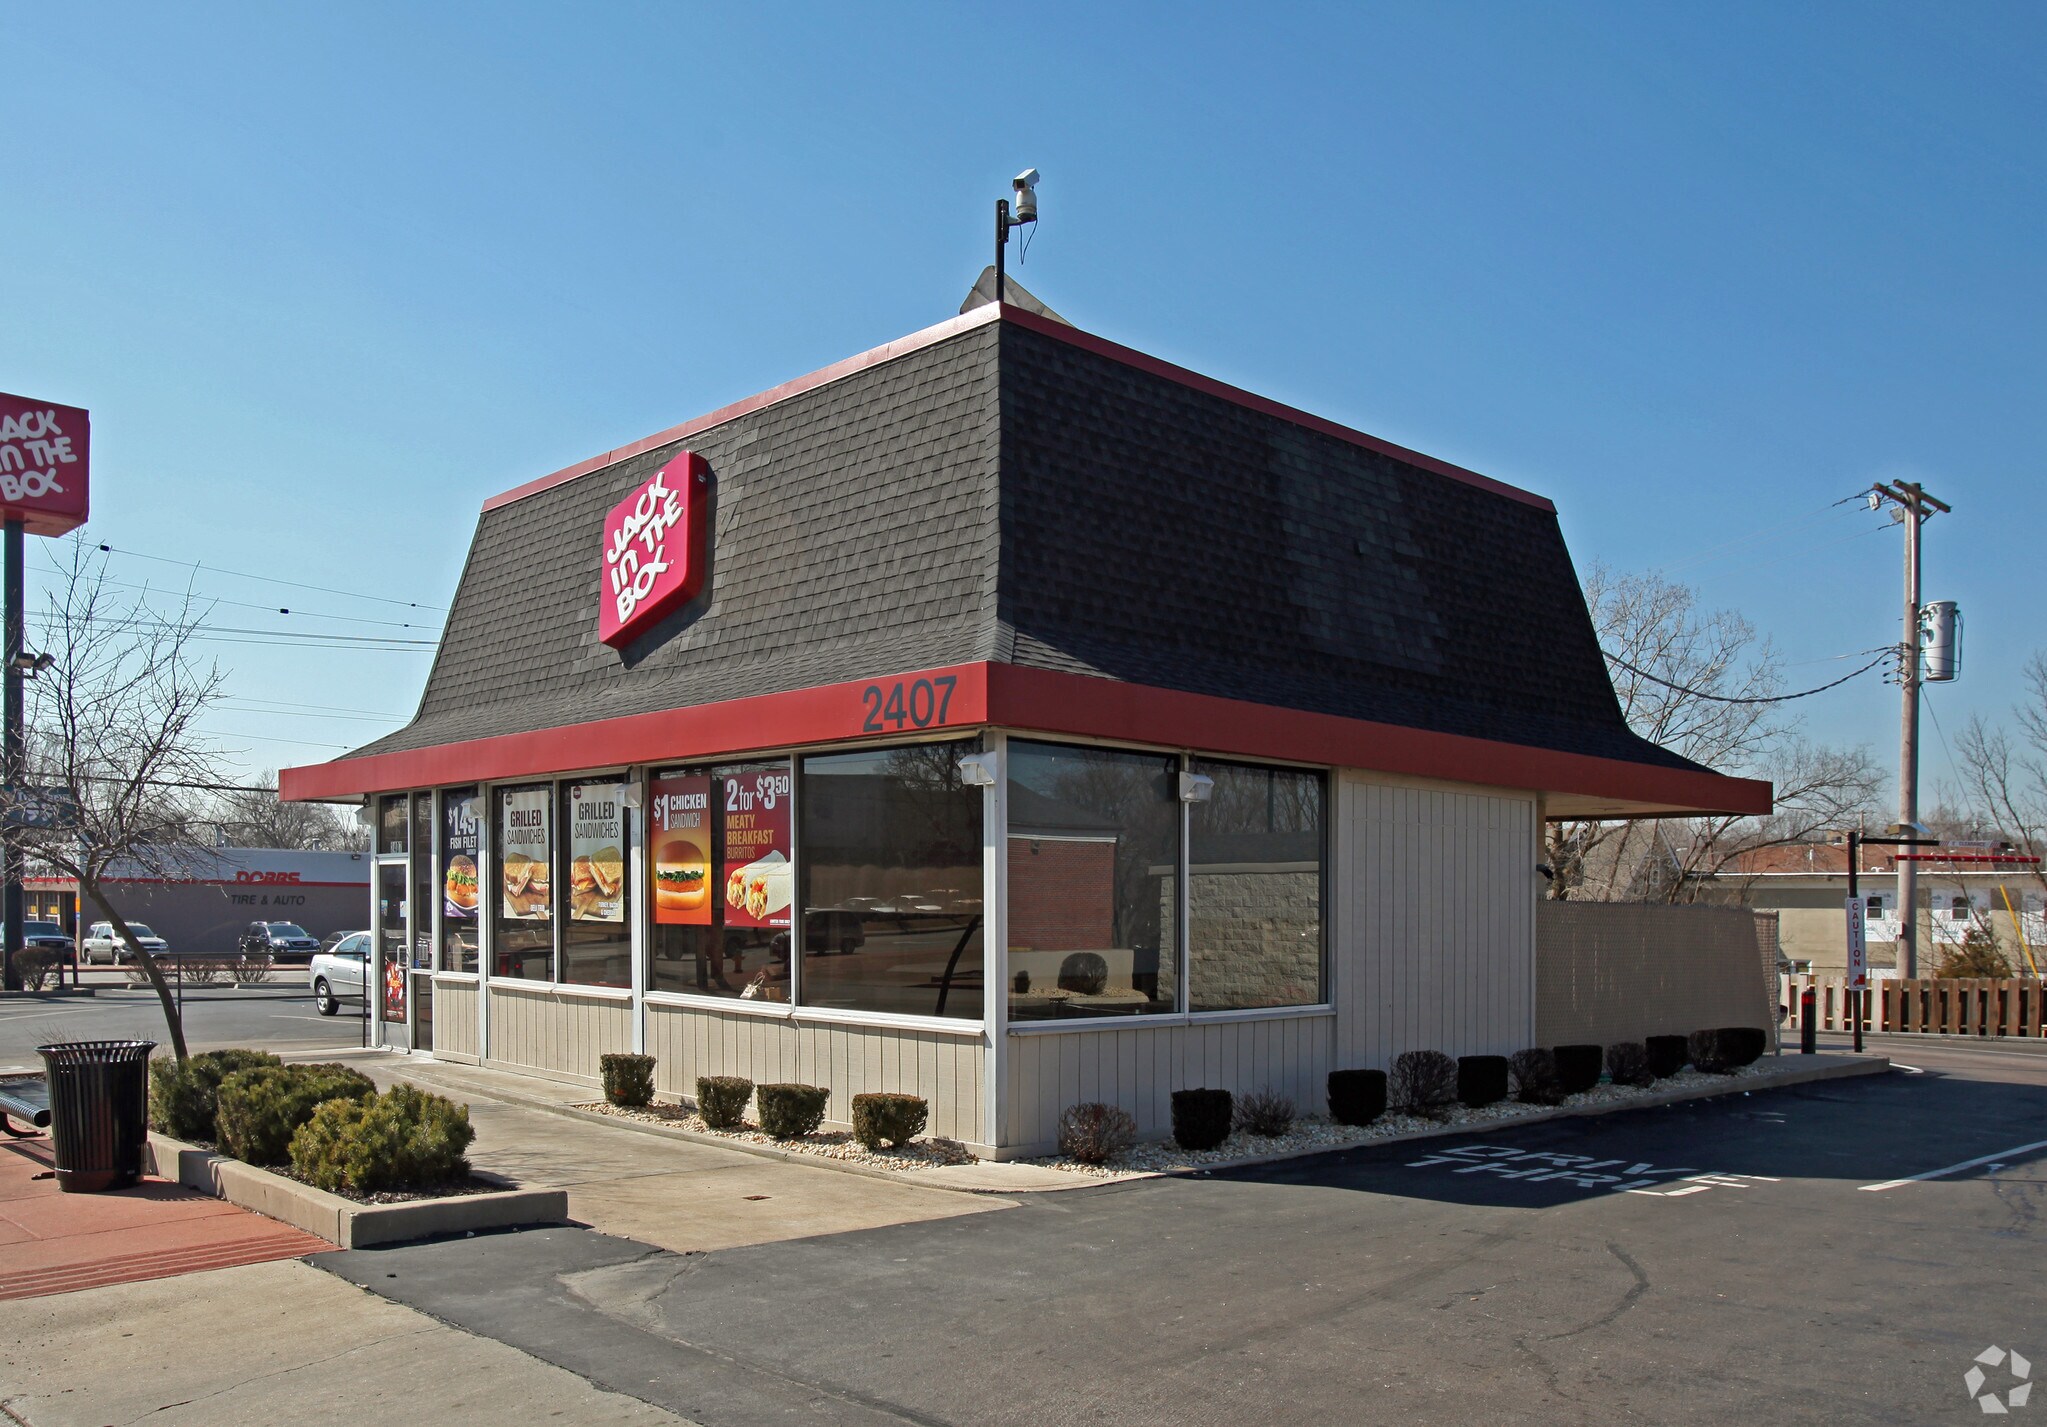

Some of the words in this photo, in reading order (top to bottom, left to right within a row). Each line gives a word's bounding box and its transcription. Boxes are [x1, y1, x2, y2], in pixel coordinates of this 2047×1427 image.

[0, 409, 62, 442] ACK
[23, 436, 78, 467] THE
[0, 467, 63, 501] BOX
[607, 472, 670, 564] JACK
[639, 490, 684, 553] THE
[616, 545, 669, 623] BOX
[863, 675, 957, 733] 2407
[670, 793, 707, 810] CHICKEN
[726, 778, 738, 812] 2
[739, 785, 755, 810] for
[511, 809, 542, 827] GRILLED
[579, 801, 615, 820] GRILLED
[653, 794, 669, 831] $1
[670, 812, 701, 829] SANDWICH
[726, 814, 755, 829] MEATY
[507, 828, 546, 845] SANDWICHES
[574, 822, 619, 839] SANDWICHES
[726, 830, 774, 845] BREAKFAST
[450, 837, 461, 849] FISH
[463, 836, 477, 848] FILET
[726, 846, 755, 859] BURRITOS
[231, 894, 256, 905] TIRE
[261, 896, 268, 905] &
[273, 895, 305, 905] AUTO
[1851, 902, 1861, 967] CAUTION
